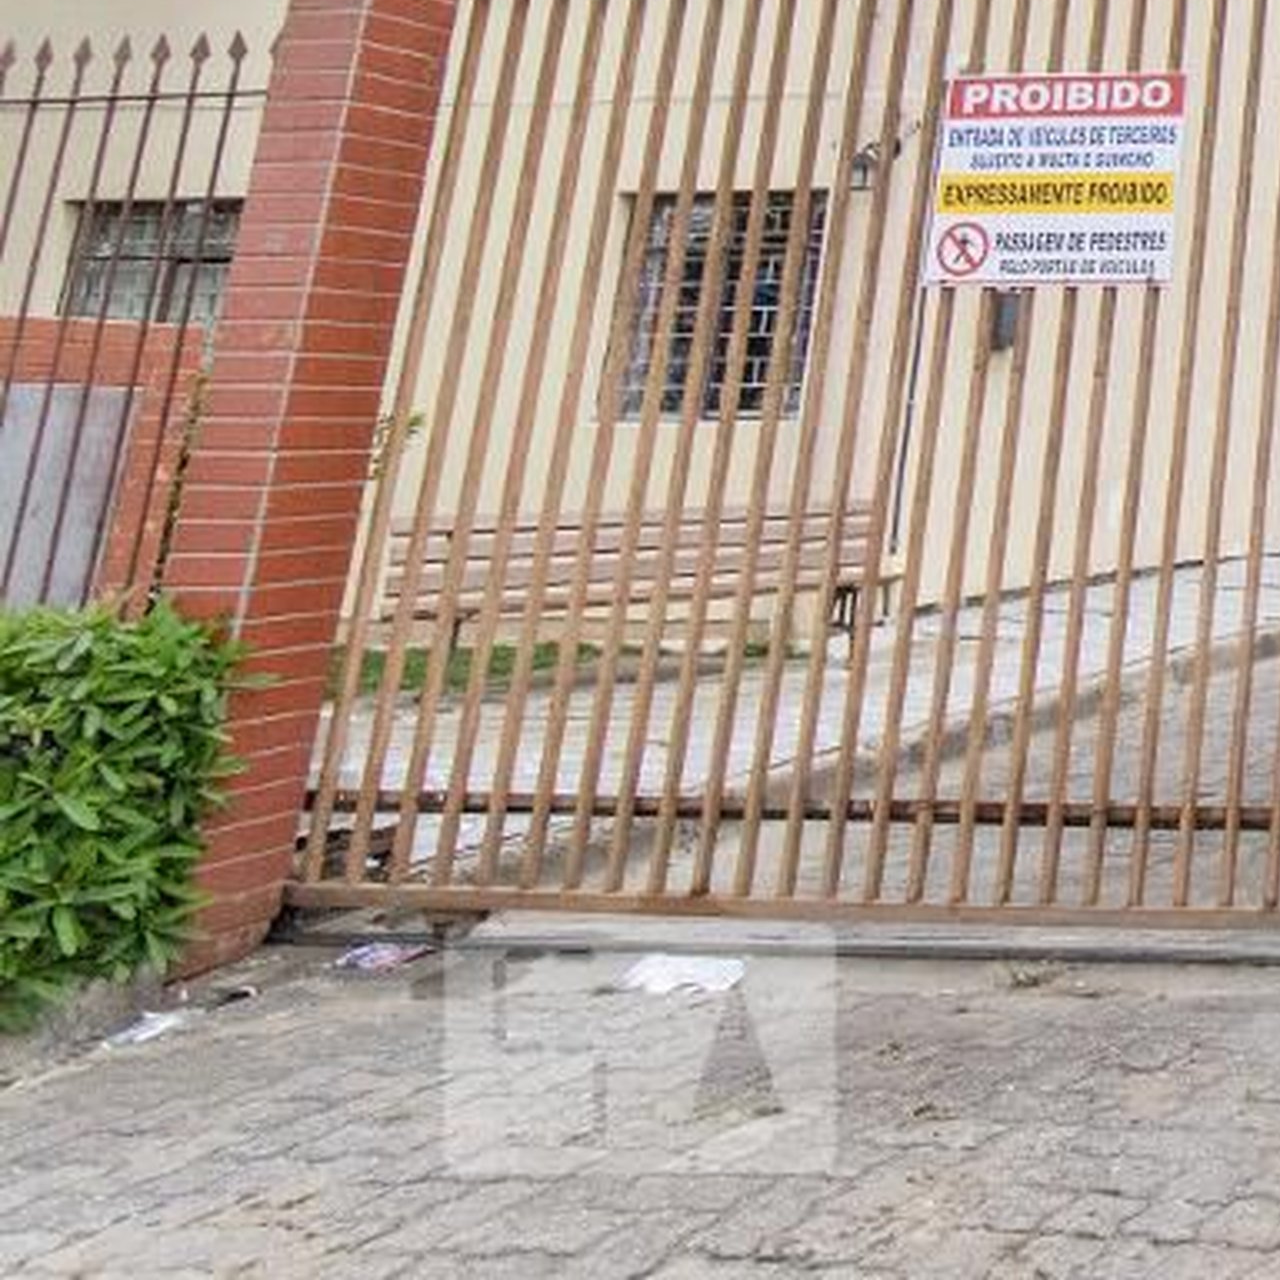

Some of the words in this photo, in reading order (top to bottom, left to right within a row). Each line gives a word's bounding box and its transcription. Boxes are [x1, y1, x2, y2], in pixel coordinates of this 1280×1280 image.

[961, 79, 1173, 114] PROIBIDO
[948, 127, 1004, 147] ENTRADA
[1008, 126, 1023, 146] DE
[1090, 126, 1107, 145] DE
[1109, 125, 1177, 145] TERCEIROS
[944, 182, 1084, 206] EXPRESSAMENTE
[1089, 182, 1168, 204] PROIBIDO
[995, 231, 1066, 252] PASSAGEM
[1068, 231, 1085, 251] DE
[1090, 230, 1167, 251] PEDESTRES
